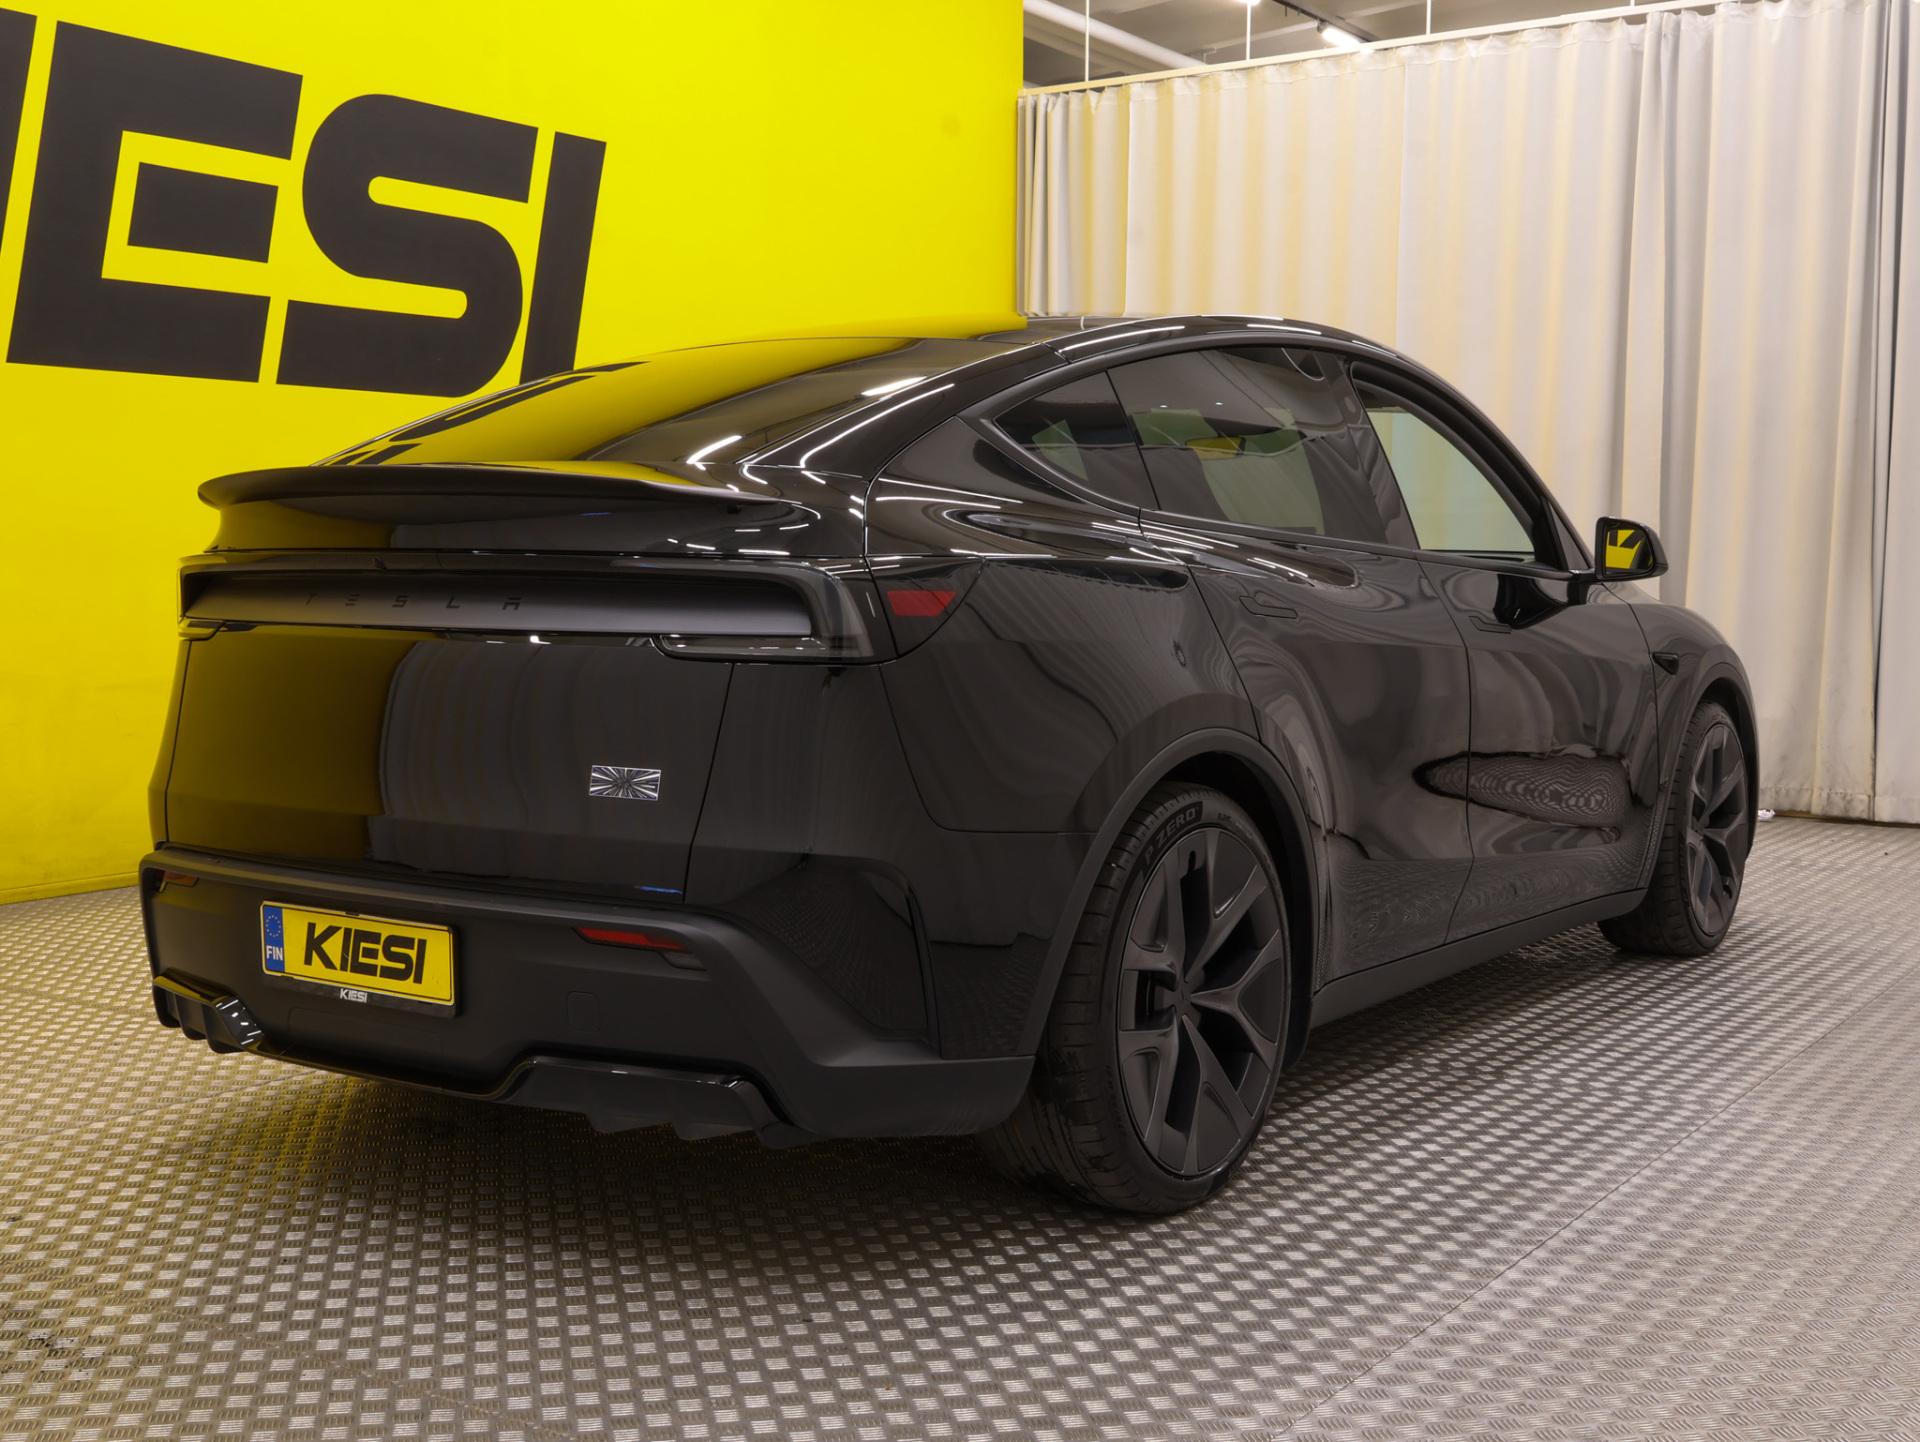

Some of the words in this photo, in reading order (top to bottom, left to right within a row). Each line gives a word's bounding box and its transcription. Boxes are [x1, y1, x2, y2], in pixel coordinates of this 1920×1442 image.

[0, 8, 607, 398] ESI
[305, 593, 521, 610] TESLA
[1156, 808, 1196, 849] ZERO
[266, 945, 283, 961] FIN
[304, 922, 427, 984] KIESI
[340, 988, 368, 1003] KIESI
